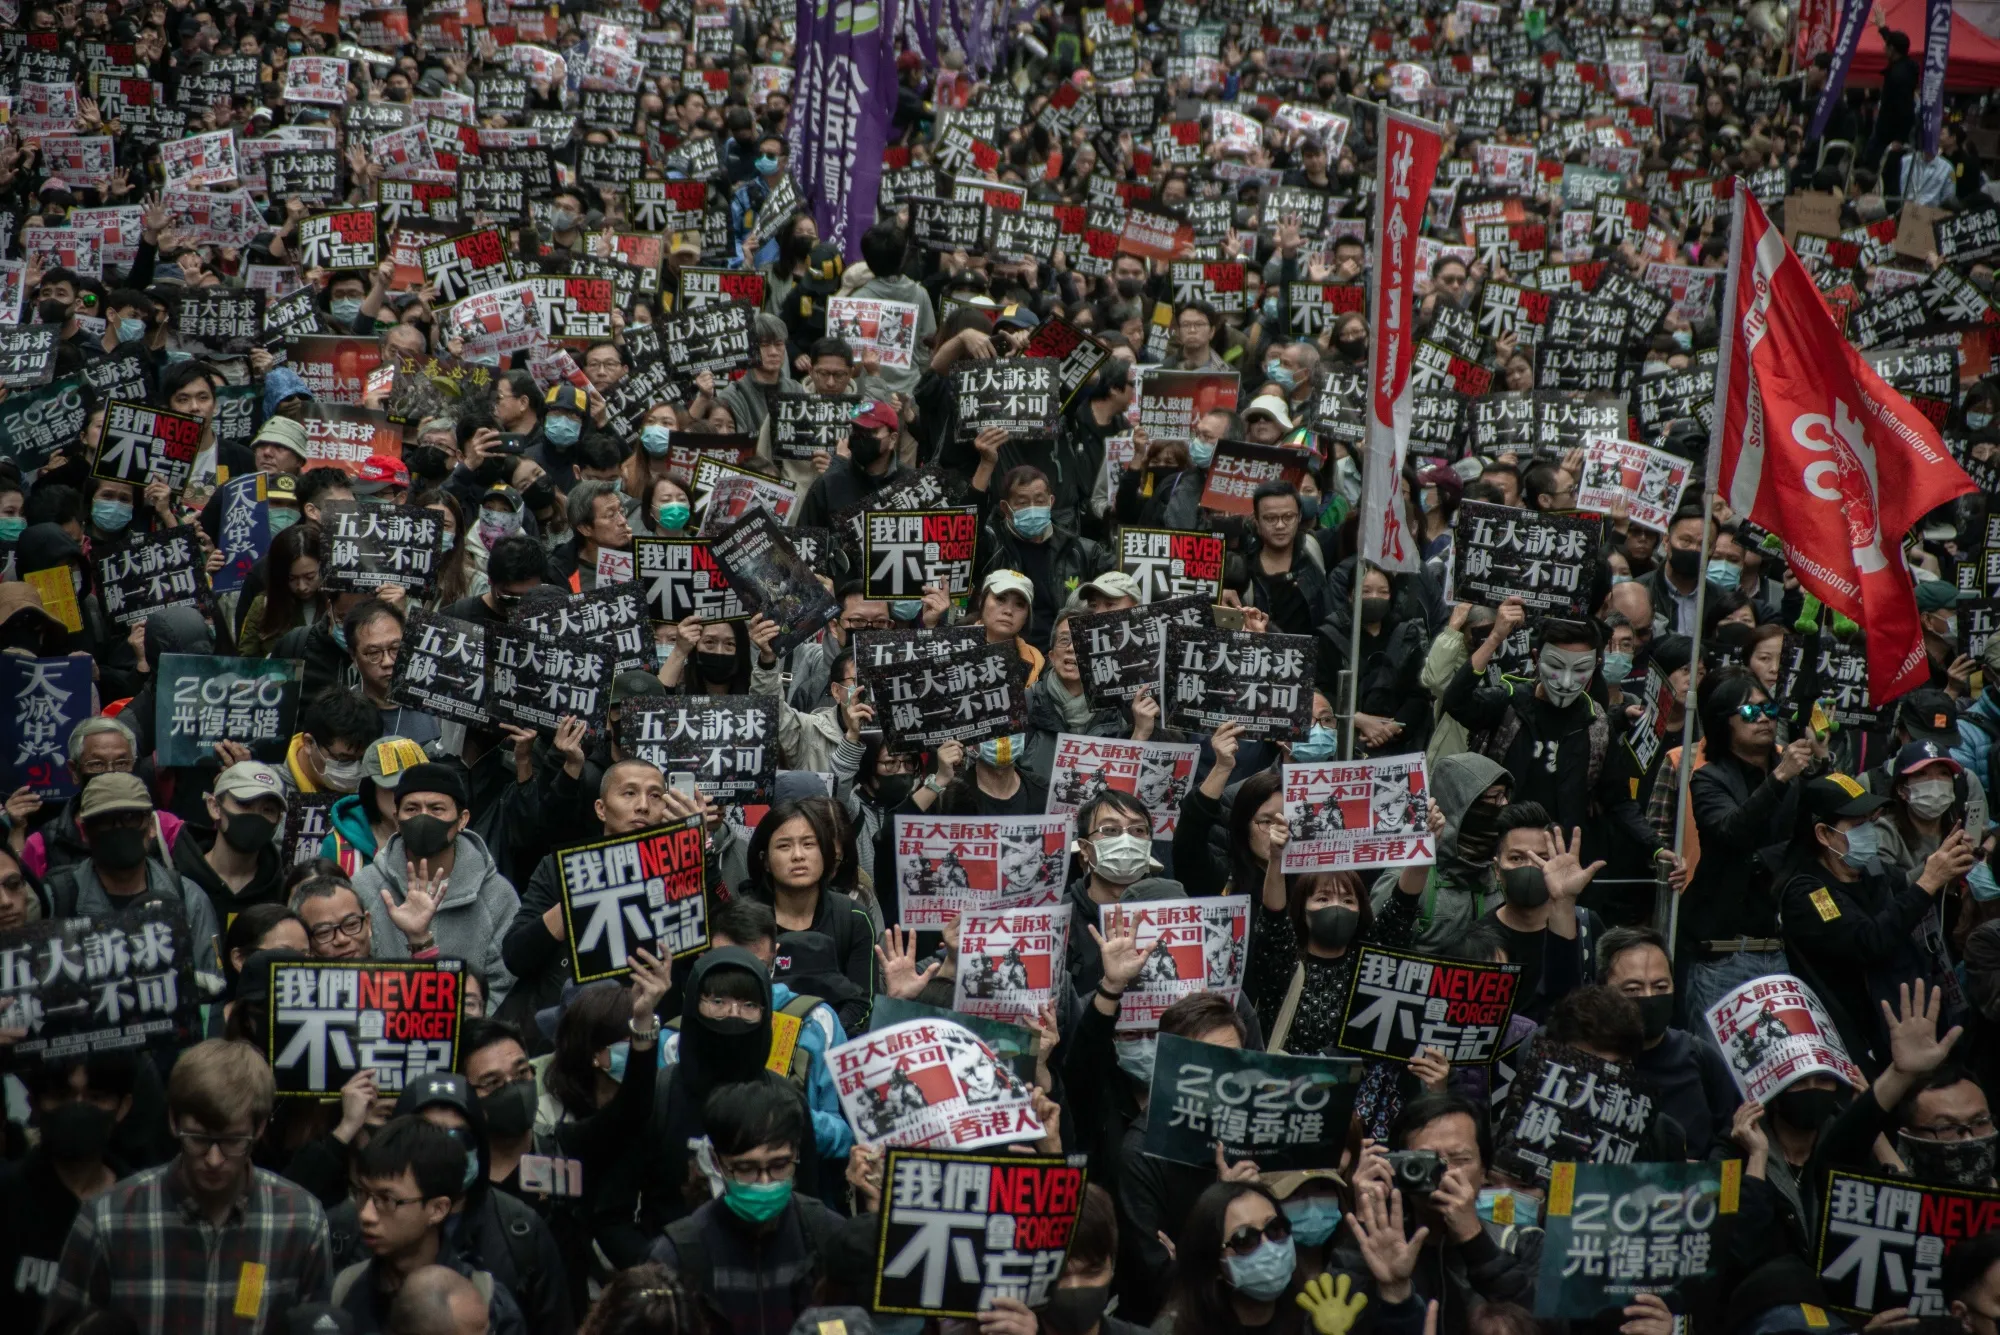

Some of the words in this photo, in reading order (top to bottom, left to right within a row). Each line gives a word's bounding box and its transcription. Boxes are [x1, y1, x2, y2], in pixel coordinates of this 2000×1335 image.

[272, 152, 336, 173] 五大訴求
[272, 174, 336, 191] 缺一不可
[462, 174, 523, 191] 五大訴求
[301, 219, 331, 239] 我們
[331, 213, 374, 232] NEVER
[915, 205, 980, 222] 五大訴求
[1000, 216, 1058, 235] 五大訴求
[1939, 211, 1999, 239] 五大訴求
[331, 243, 376, 265] 忘記
[424, 241, 456, 266] 我們
[684, 273, 719, 292] 我們
[1292, 285, 1322, 302] 我們
[181, 299, 256, 319] 五大訴求
[565, 312, 612, 336] 忘記
[1557, 300, 1628, 326] 五大訴求
[1857, 290, 1920, 327] 五大訴求
[180, 316, 256, 337] 堅持到底
[665, 310, 746, 343] 五大訴求
[667, 333, 749, 361] 缺一不可
[1417, 348, 1449, 373] 我們
[1544, 348, 1618, 369] 五大訴求
[958, 366, 1050, 394] 五大訴求
[1542, 369, 1614, 390] 缺一不可
[1637, 370, 1714, 402] 五大訴求
[4, 388, 81, 432] 2020
[959, 394, 1049, 420] 缺一不可
[1541, 399, 1618, 424] 五大訴求
[111, 406, 156, 437] 我們
[155, 416, 200, 448] NEVER
[304, 418, 375, 442] 五大訴求
[1879, 405, 1943, 465] International
[102, 429, 148, 480] 不
[1215, 455, 1284, 481] 五大訴求
[225, 479, 260, 564] 天滅中共
[333, 512, 436, 544] 五大訴求
[871, 516, 923, 543] 我們
[923, 515, 975, 541] NEVER
[1468, 517, 1587, 560] 五大訴求
[332, 540, 434, 574] 缺一不可
[639, 543, 692, 571] 我們
[712, 538, 735, 557] Never
[733, 524, 752, 543] give
[724, 550, 744, 565] Show
[1124, 532, 1170, 557] 我們
[1170, 534, 1222, 562] NEVER
[99, 538, 190, 583] 五大訴求
[871, 543, 923, 595] 不
[924, 560, 972, 593] 忘記
[1465, 548, 1583, 591] 缺一不可
[1791, 547, 1860, 597] Internacional
[104, 566, 196, 615] 缺一不可
[640, 571, 692, 619] 不
[1123, 557, 1170, 603] 不
[693, 589, 750, 621] 忘記
[494, 636, 603, 683] 五大訴求
[1179, 640, 1304, 679] 五大訴求
[173, 676, 283, 706] 2020
[494, 666, 600, 715] 缺一不可
[888, 655, 1008, 703] 五大訴求
[1177, 672, 1302, 713] 缺一不可
[13, 659, 73, 766] 天滅中共
[170, 705, 279, 738] 光復香港
[892, 683, 1011, 731] 缺一不可
[636, 708, 767, 742] 五大訴求
[1056, 755, 1140, 777] 缺一不可
[1061, 740, 1143, 760] 五大訴求
[1286, 784, 1373, 802] 缺一不可
[1288, 766, 1373, 786] 五大訴求
[901, 822, 1000, 840] 五大訴求
[563, 842, 643, 893] 我們
[637, 827, 701, 881] NEVER
[899, 840, 997, 859] 缺一不可
[1352, 839, 1433, 863] 香港人
[571, 885, 652, 969] 不
[651, 903, 705, 959] 忘記
[963, 912, 1051, 935] 五大訴求
[961, 935, 1051, 954] 缺一不可
[276, 970, 358, 1009] 我們
[360, 971, 456, 1010] NEVER
[1360, 953, 1434, 996] 我們
[1429, 965, 1515, 1003] NEVER
[1712, 974, 1800, 1025] 五大訴求
[1347, 983, 1427, 1052] 不
[1719, 997, 1807, 1043] 缺一不可
[275, 1010, 358, 1091] 不
[834, 1026, 936, 1075] 五大訴求
[1413, 1021, 1499, 1060] 忘記
[358, 1039, 452, 1091] 忘記
[838, 1046, 945, 1096] 缺一不可
[1177, 1064, 1331, 1111] 2020
[1533, 1059, 1652, 1135] 五大訴求
[949, 1110, 1042, 1145] 香港人
[1168, 1097, 1324, 1145] 光復香港
[894, 1160, 992, 1211] 我們
[991, 1166, 1082, 1213] NEVER
[1572, 1193, 1717, 1232] 2020
[1831, 1179, 1922, 1233] 我們
[883, 1210, 988, 1308] 不
[1561, 1232, 1711, 1279] 光復香港
[1822, 1220, 1915, 1310] 不
[979, 1249, 1067, 1311] 忘記
